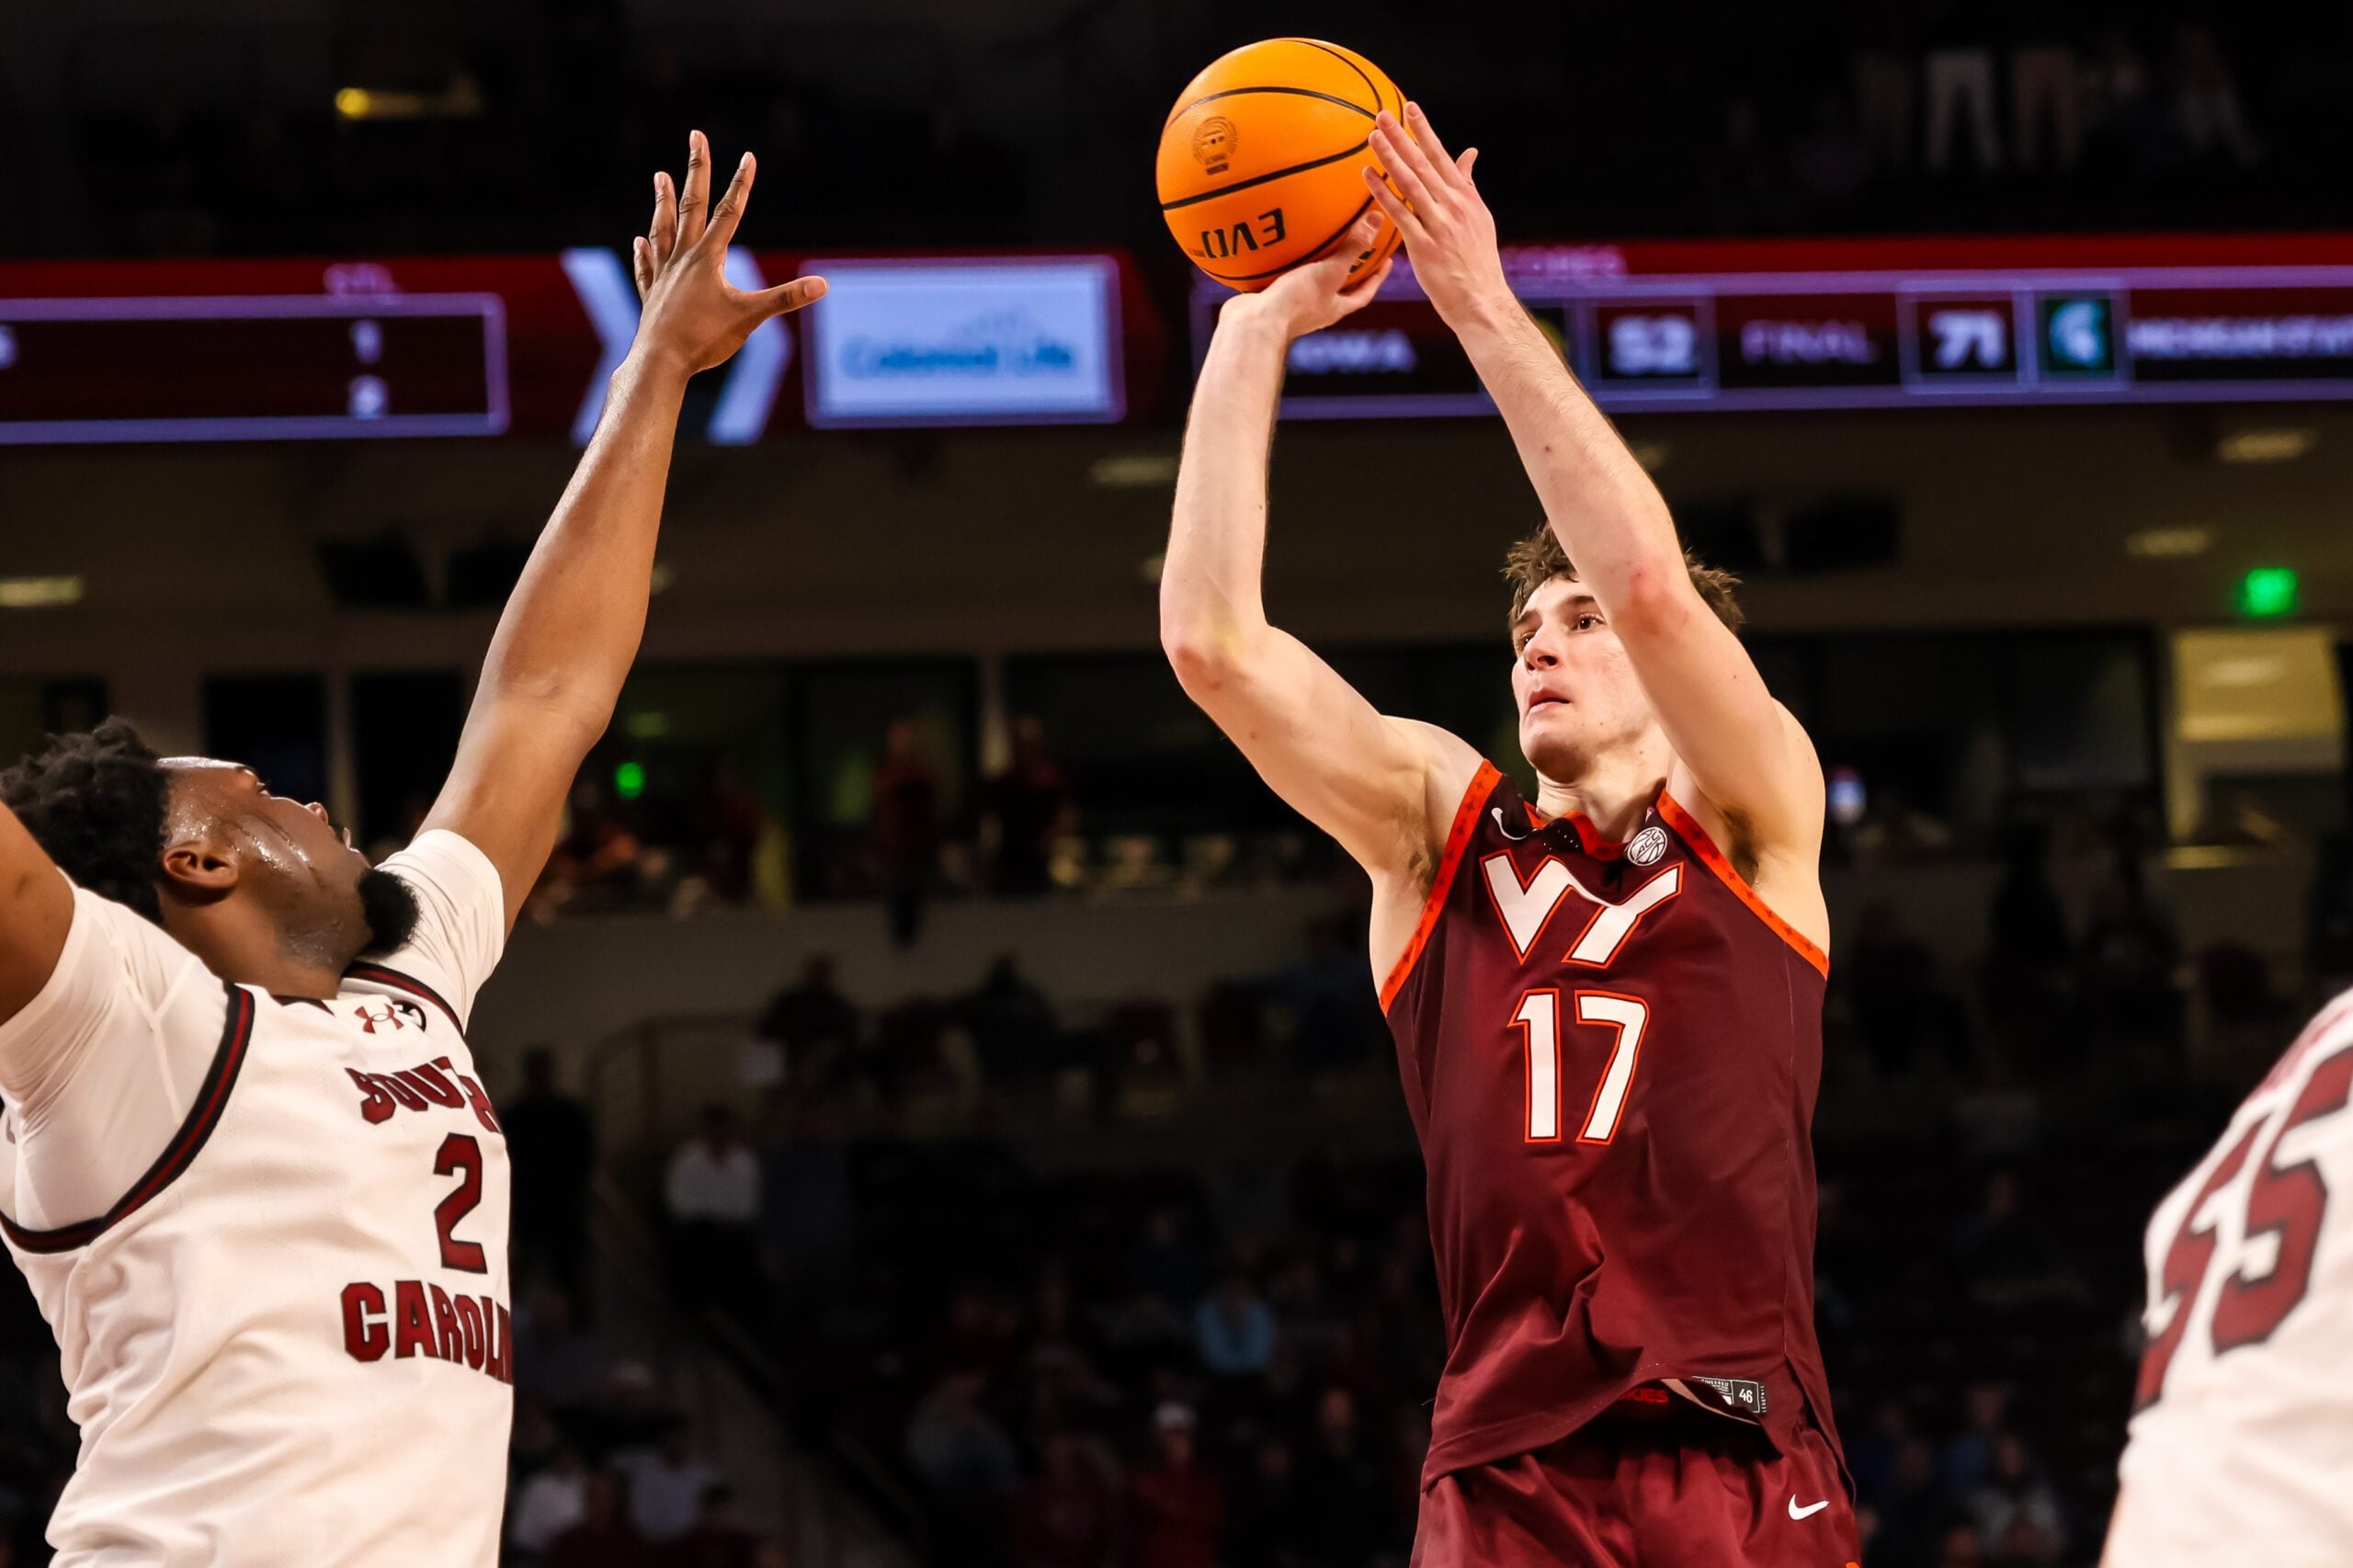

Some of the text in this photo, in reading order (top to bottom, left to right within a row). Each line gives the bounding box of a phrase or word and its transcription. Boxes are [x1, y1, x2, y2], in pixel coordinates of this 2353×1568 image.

[1201, 208, 1286, 258] EVO
[1929, 310, 2006, 368] 71
[1506, 987, 1651, 1146] 17
[433, 1132, 488, 1275] 2
[1738, 1388, 1753, 1403] 46
